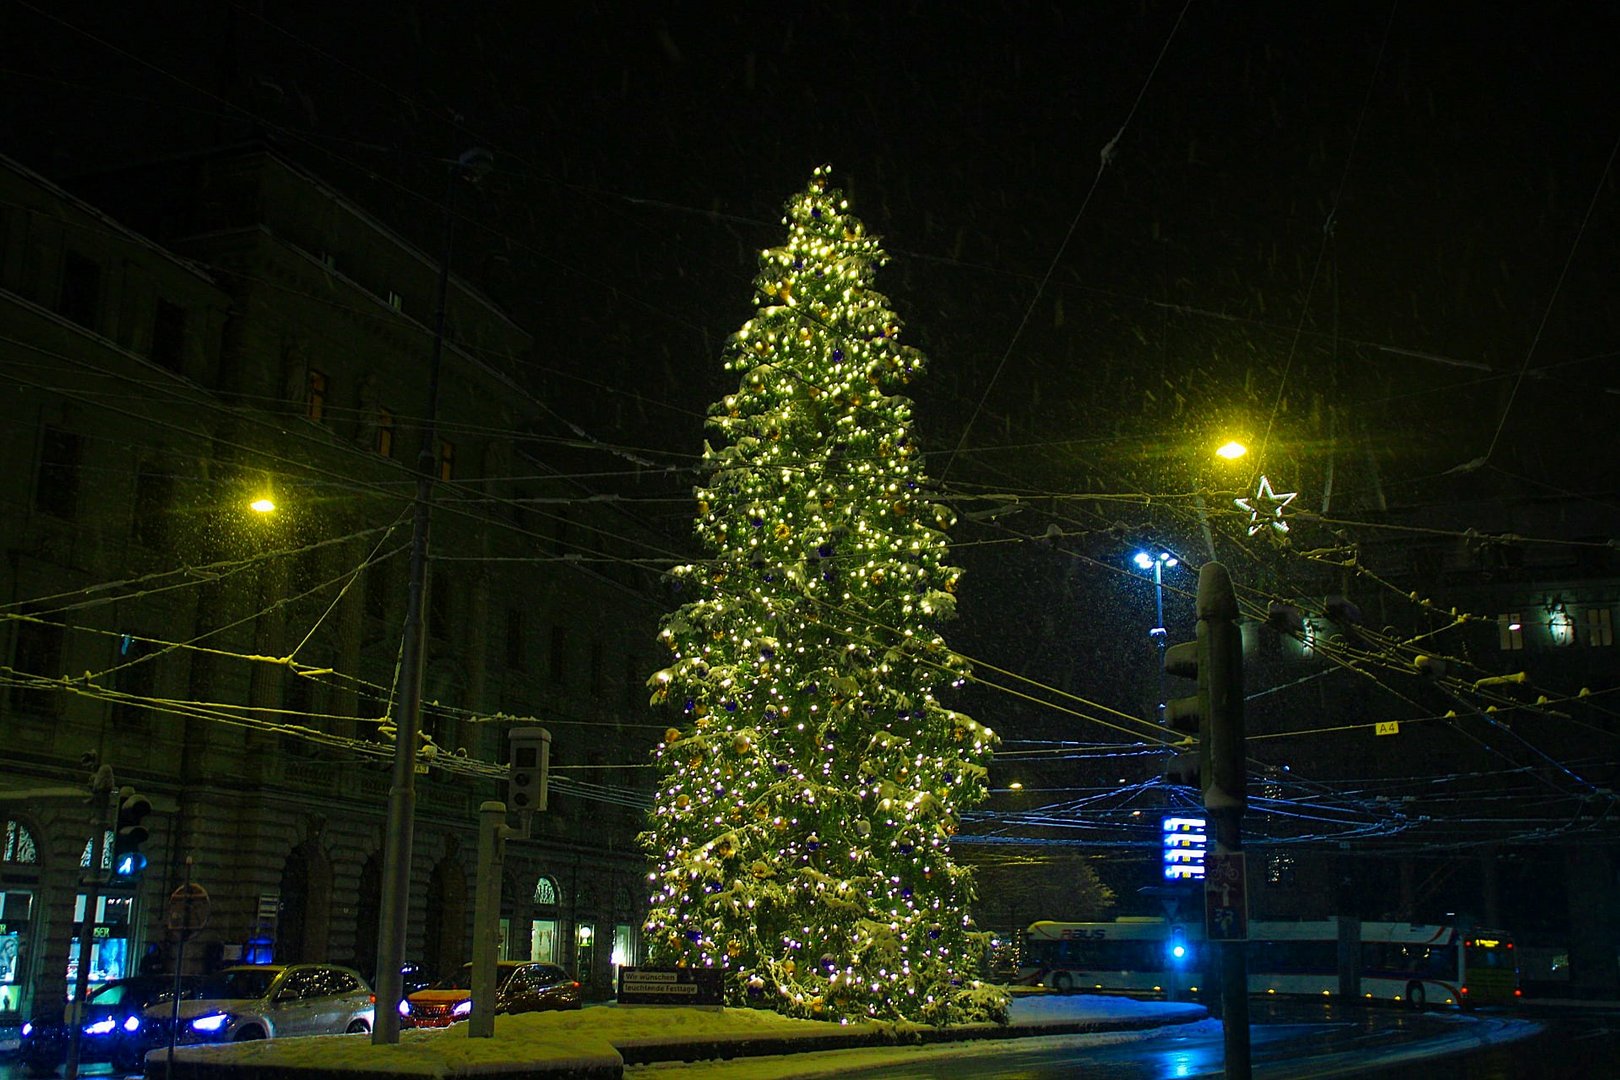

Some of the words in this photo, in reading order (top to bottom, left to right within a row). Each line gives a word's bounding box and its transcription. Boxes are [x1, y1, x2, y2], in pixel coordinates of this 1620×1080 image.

[625, 973, 637, 981] Wir
[640, 973, 675, 981] wünschen
[625, 984, 664, 992] leuchtende
[666, 985, 696, 993] Festtage
